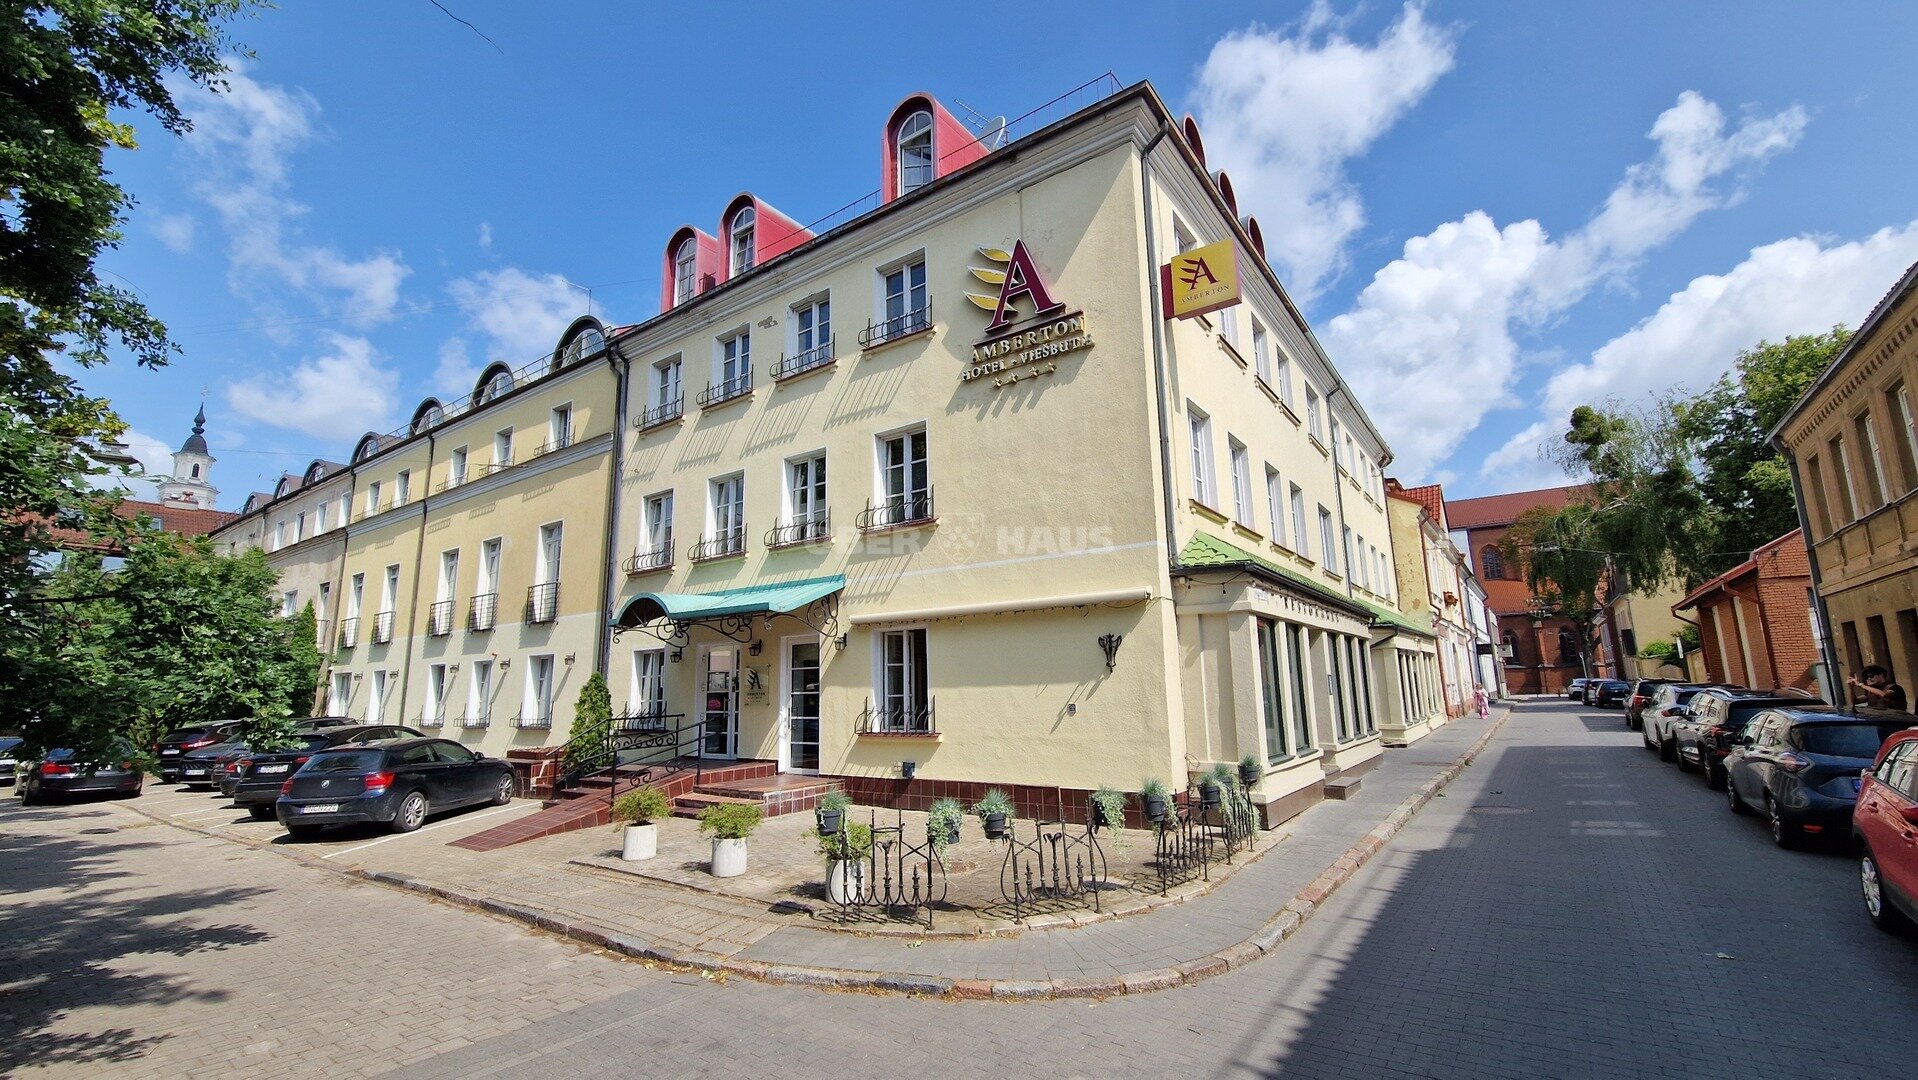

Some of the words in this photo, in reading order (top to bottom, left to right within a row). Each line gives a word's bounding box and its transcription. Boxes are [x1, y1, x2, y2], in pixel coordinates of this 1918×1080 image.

[984, 239, 1066, 333] A
[1181, 284, 1231, 304] AMBERTON
[971, 315, 1086, 364] AMBERTON
[961, 359, 1007, 382] HOTEL
